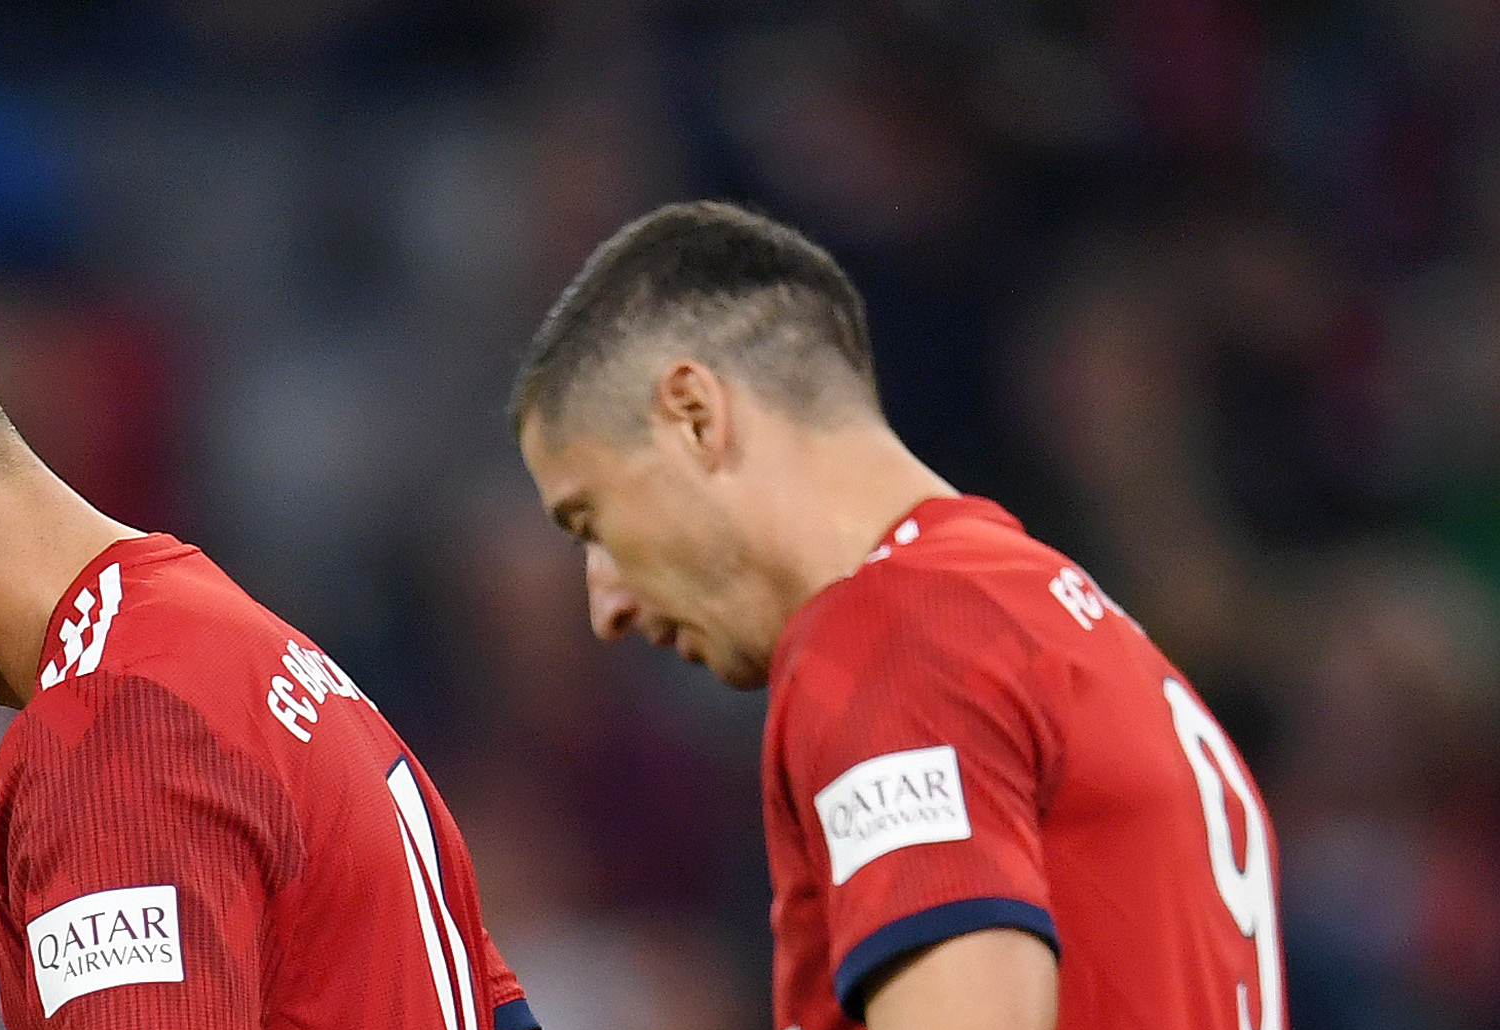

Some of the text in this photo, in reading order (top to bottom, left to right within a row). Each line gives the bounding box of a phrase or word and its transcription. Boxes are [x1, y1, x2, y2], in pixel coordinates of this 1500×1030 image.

[267, 674, 318, 743] FC
[828, 770, 949, 839] QATAR
[38, 906, 170, 970] QATAR
[63, 943, 173, 982] AIRWAYS
